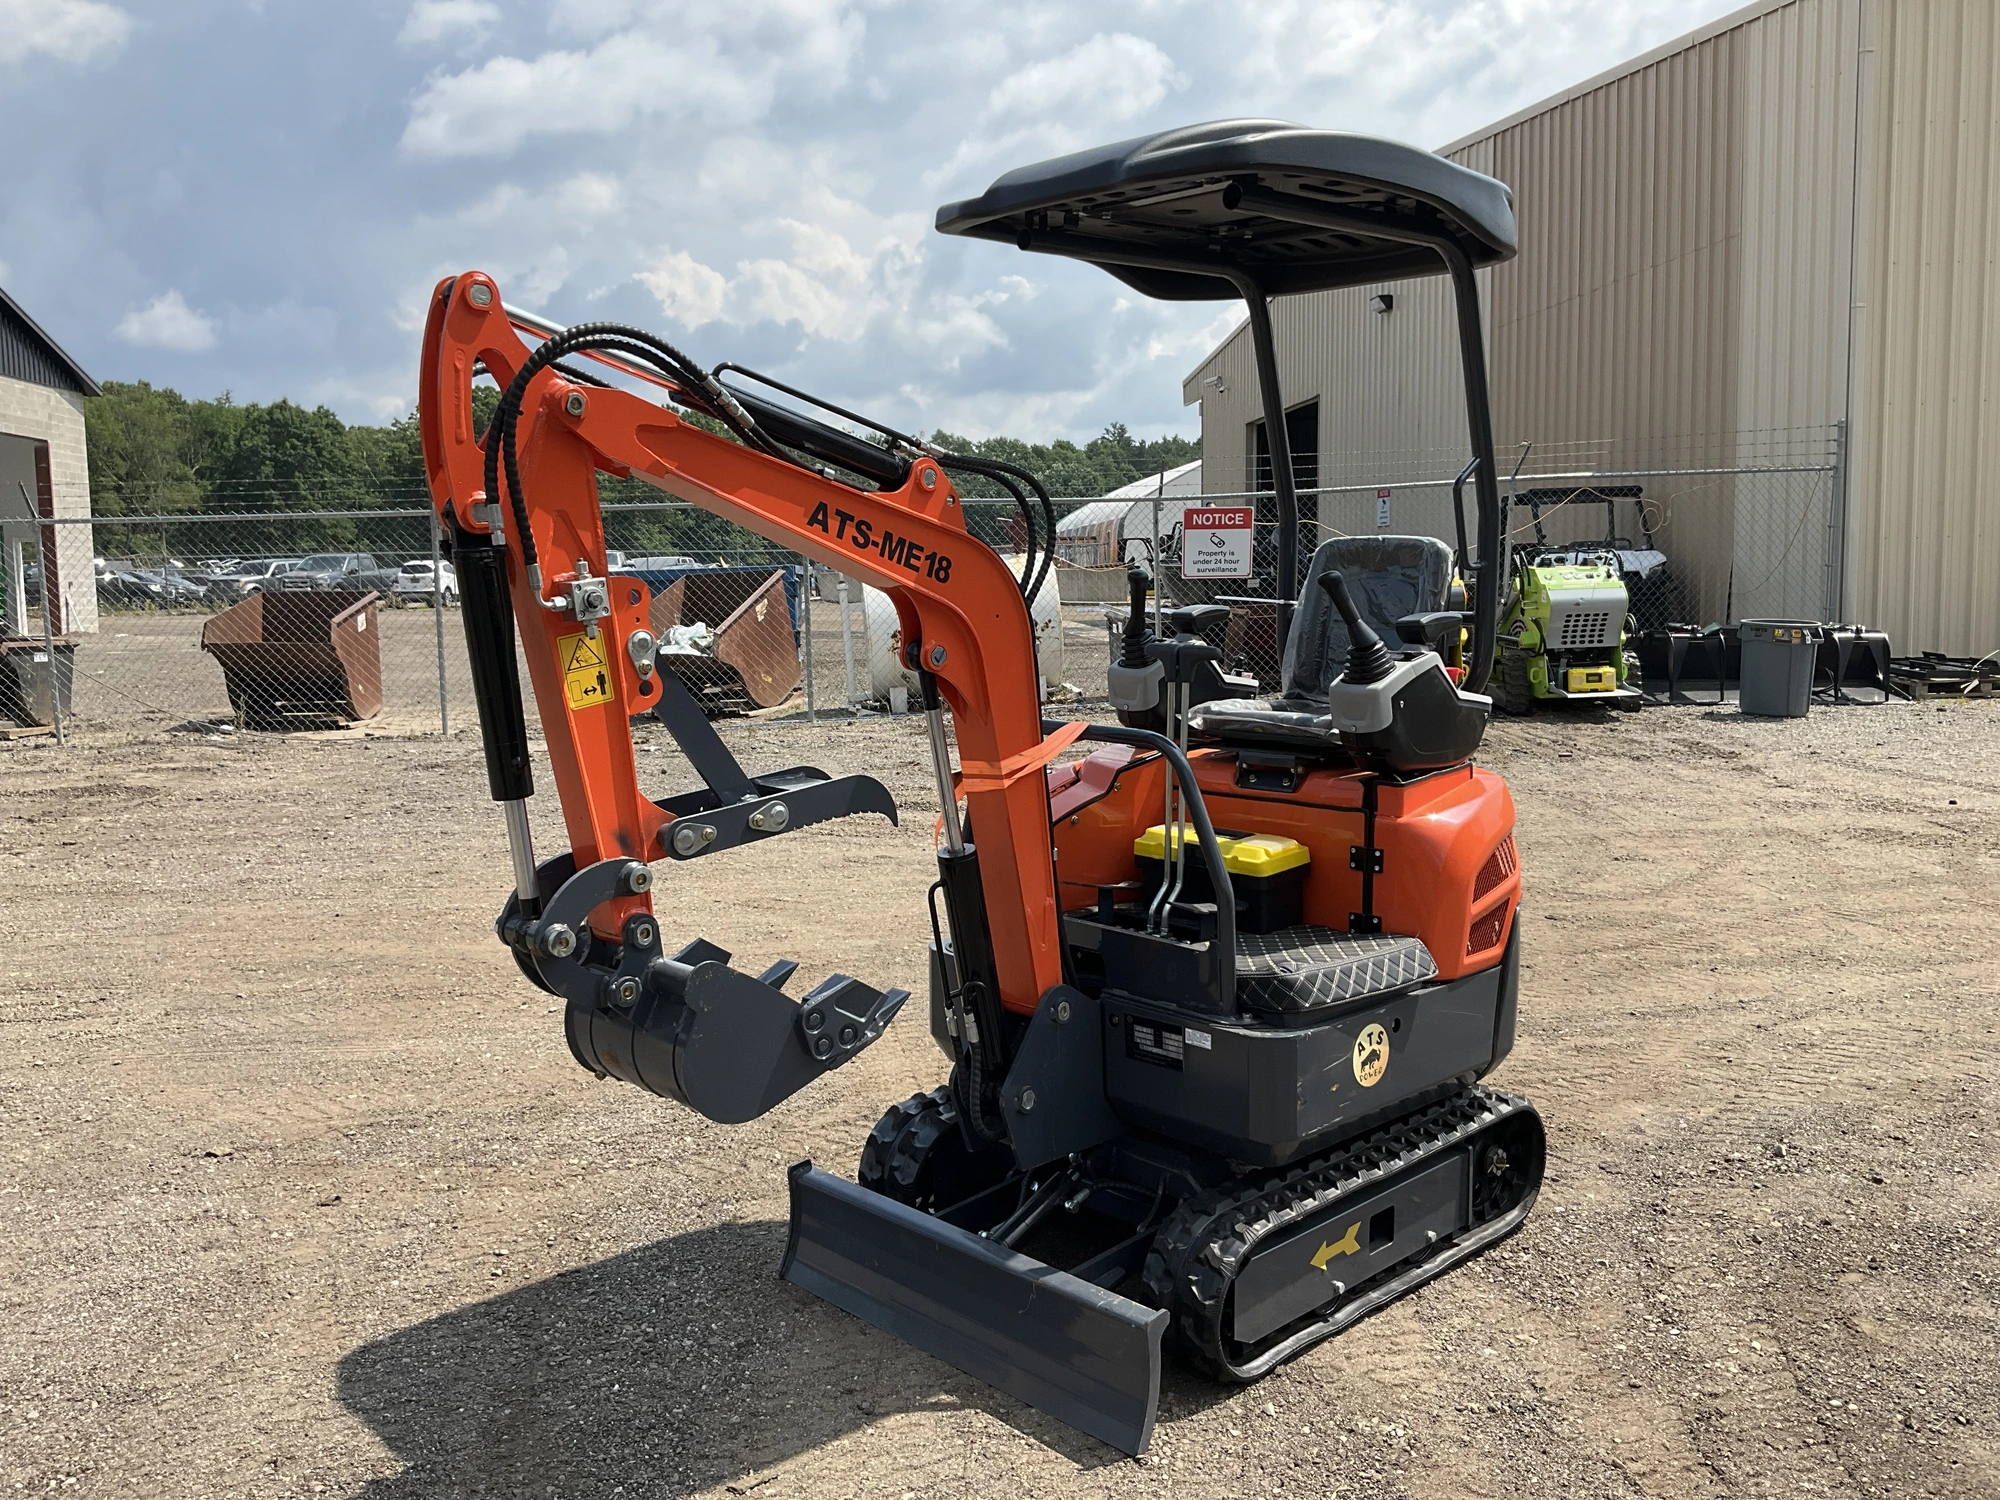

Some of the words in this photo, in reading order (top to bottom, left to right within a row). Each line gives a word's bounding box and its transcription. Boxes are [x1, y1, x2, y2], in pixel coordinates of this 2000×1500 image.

[1192, 513, 1244, 525] NOTICE
[806, 501, 952, 584] ATS-ME18
[1358, 1031, 1384, 1057] ATS
